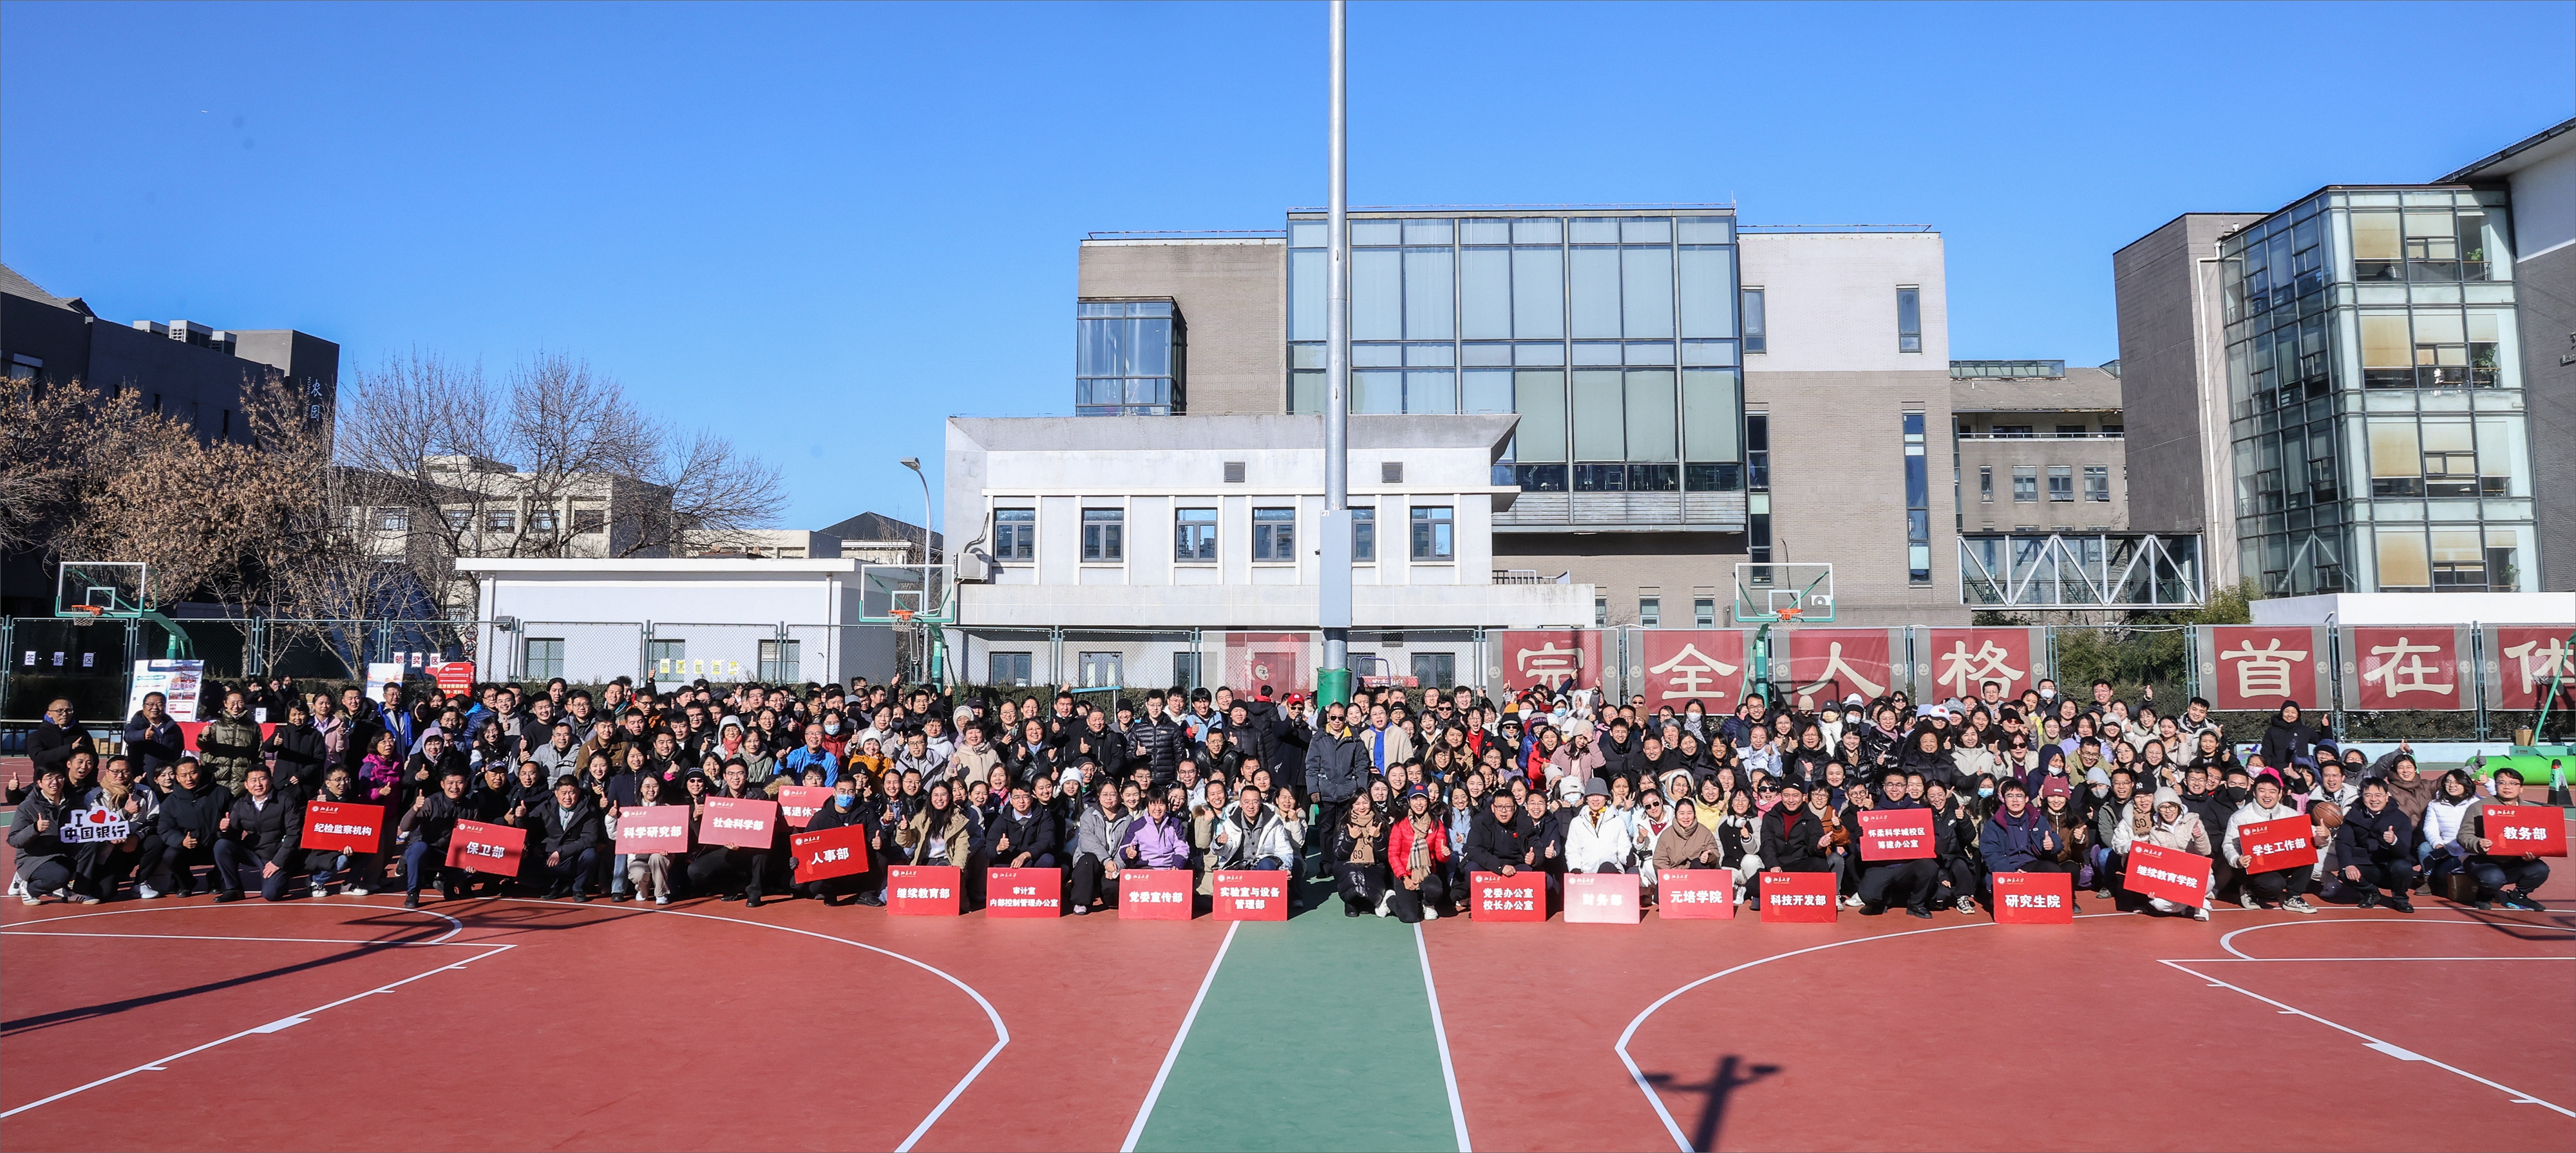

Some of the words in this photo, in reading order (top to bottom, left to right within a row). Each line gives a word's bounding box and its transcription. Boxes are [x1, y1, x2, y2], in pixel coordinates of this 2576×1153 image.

[310, 379, 322, 422] 农园
[2550, 774, 2555, 783] 3
[75, 813, 83, 827] I
[713, 818, 764, 830] 社会科学部
[64, 825, 126, 840] 中国银行
[314, 823, 372, 836] 纪检监察机构
[623, 826, 682, 838] 科学研究部
[1868, 827, 1926, 838] 怀柔科学城校区
[2503, 826, 2547, 841] 教务部
[466, 841, 506, 859] 保卫部
[1877, 839, 1918, 849] 筹建办公室
[2252, 838, 2306, 856] 学生工作部
[811, 847, 849, 865] 人事部
[2136, 865, 2198, 888] 继续教育学院
[896, 888, 951, 899] 继续教育部
[1012, 886, 1036, 895] 审计室
[1220, 886, 1280, 897] 实验室与设备
[1482, 888, 1534, 898] 党委办公室
[1670, 890, 1723, 903] 元培学院
[990, 898, 1059, 907] 内部控制管理办公室
[1129, 891, 1183, 903] 党委宣传部
[1582, 894, 1622, 906] 财务部
[1770, 894, 1826, 906] 科技开发部
[2005, 894, 2061, 908] 研究生院
[1235, 899, 1265, 910] 管理部
[1482, 900, 1534, 910] 校长办公室
